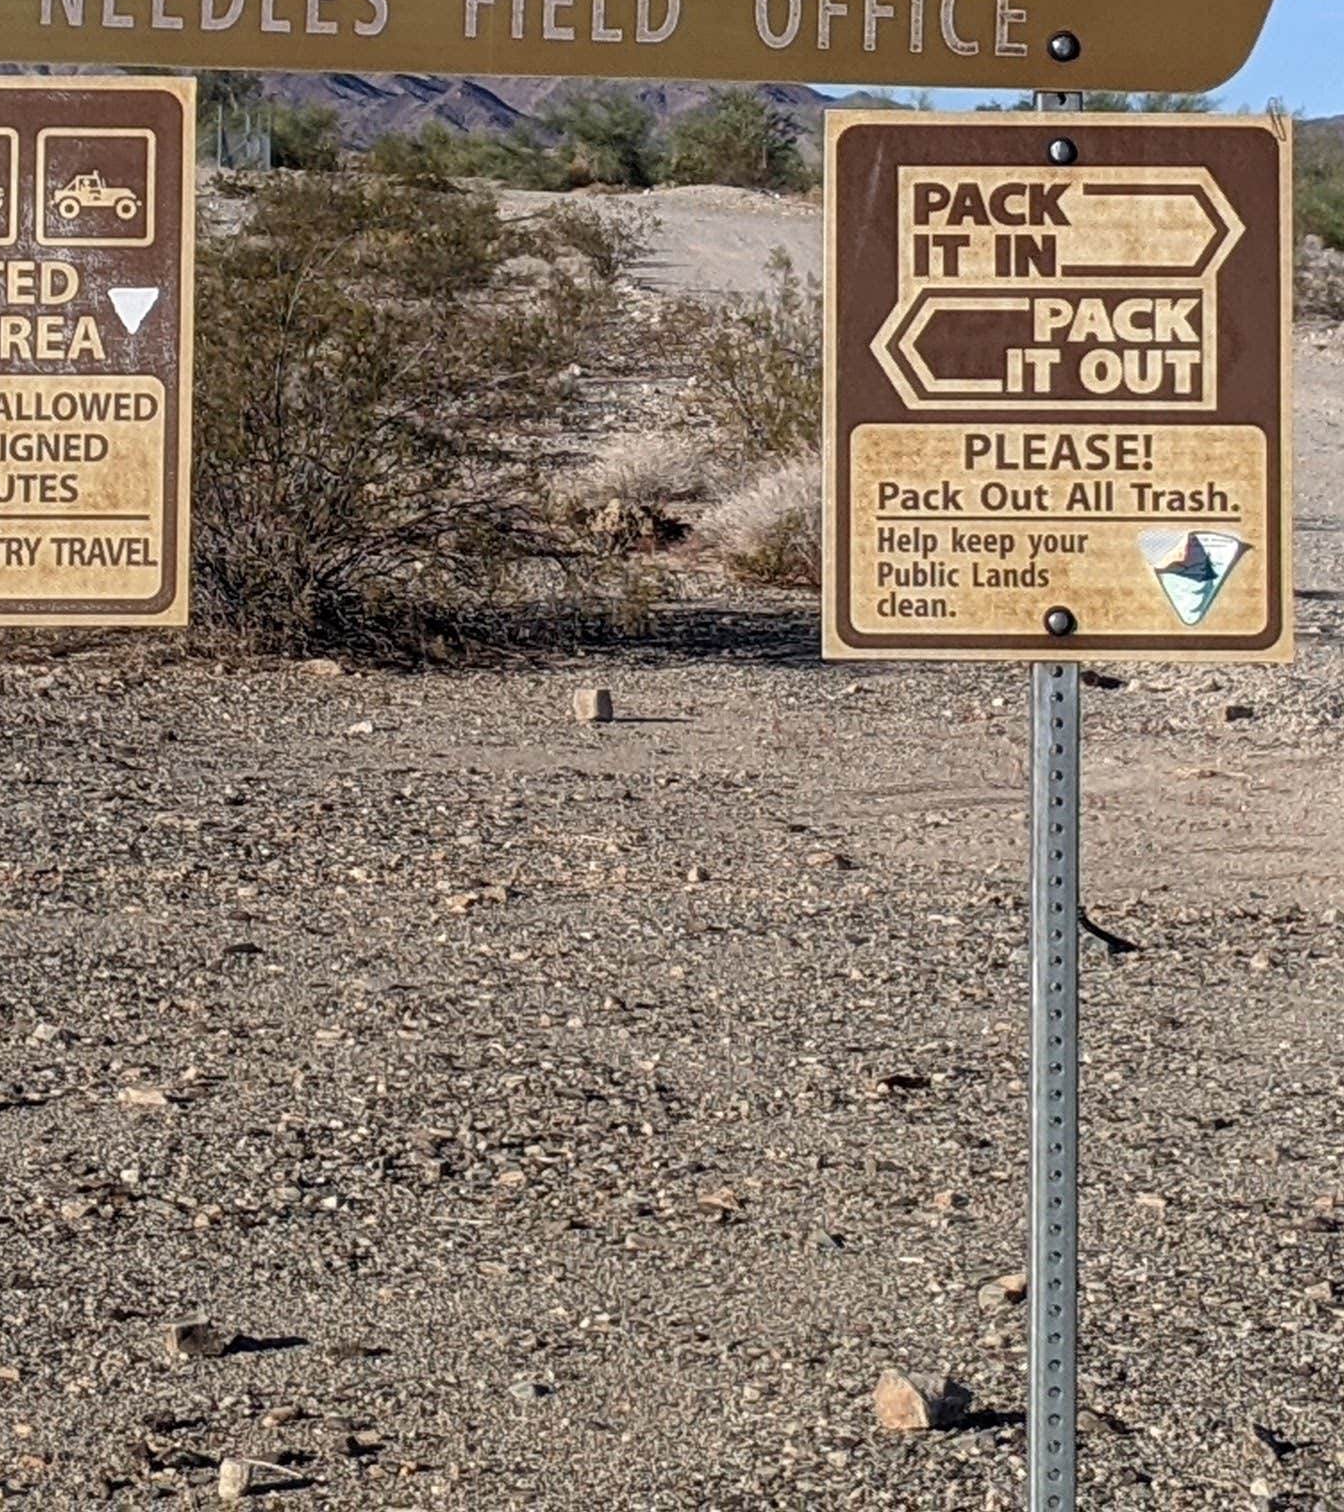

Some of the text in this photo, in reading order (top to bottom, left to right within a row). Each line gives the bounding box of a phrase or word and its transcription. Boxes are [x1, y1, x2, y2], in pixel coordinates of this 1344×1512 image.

[912, 182, 1073, 227] PACK
[912, 234, 1058, 278] IT IN
[1032, 297, 1201, 344] PACK
[1006, 348, 1202, 395] IT OUT
[963, 433, 1155, 471] PLEASE!
[877, 481, 1241, 513] Pack Out All Trash.
[54, 537, 158, 567] TRAVEL
[877, 527, 1089, 558] Help keep your
[877, 561, 1050, 589] Public Lands
[876, 590, 957, 619] clean.
